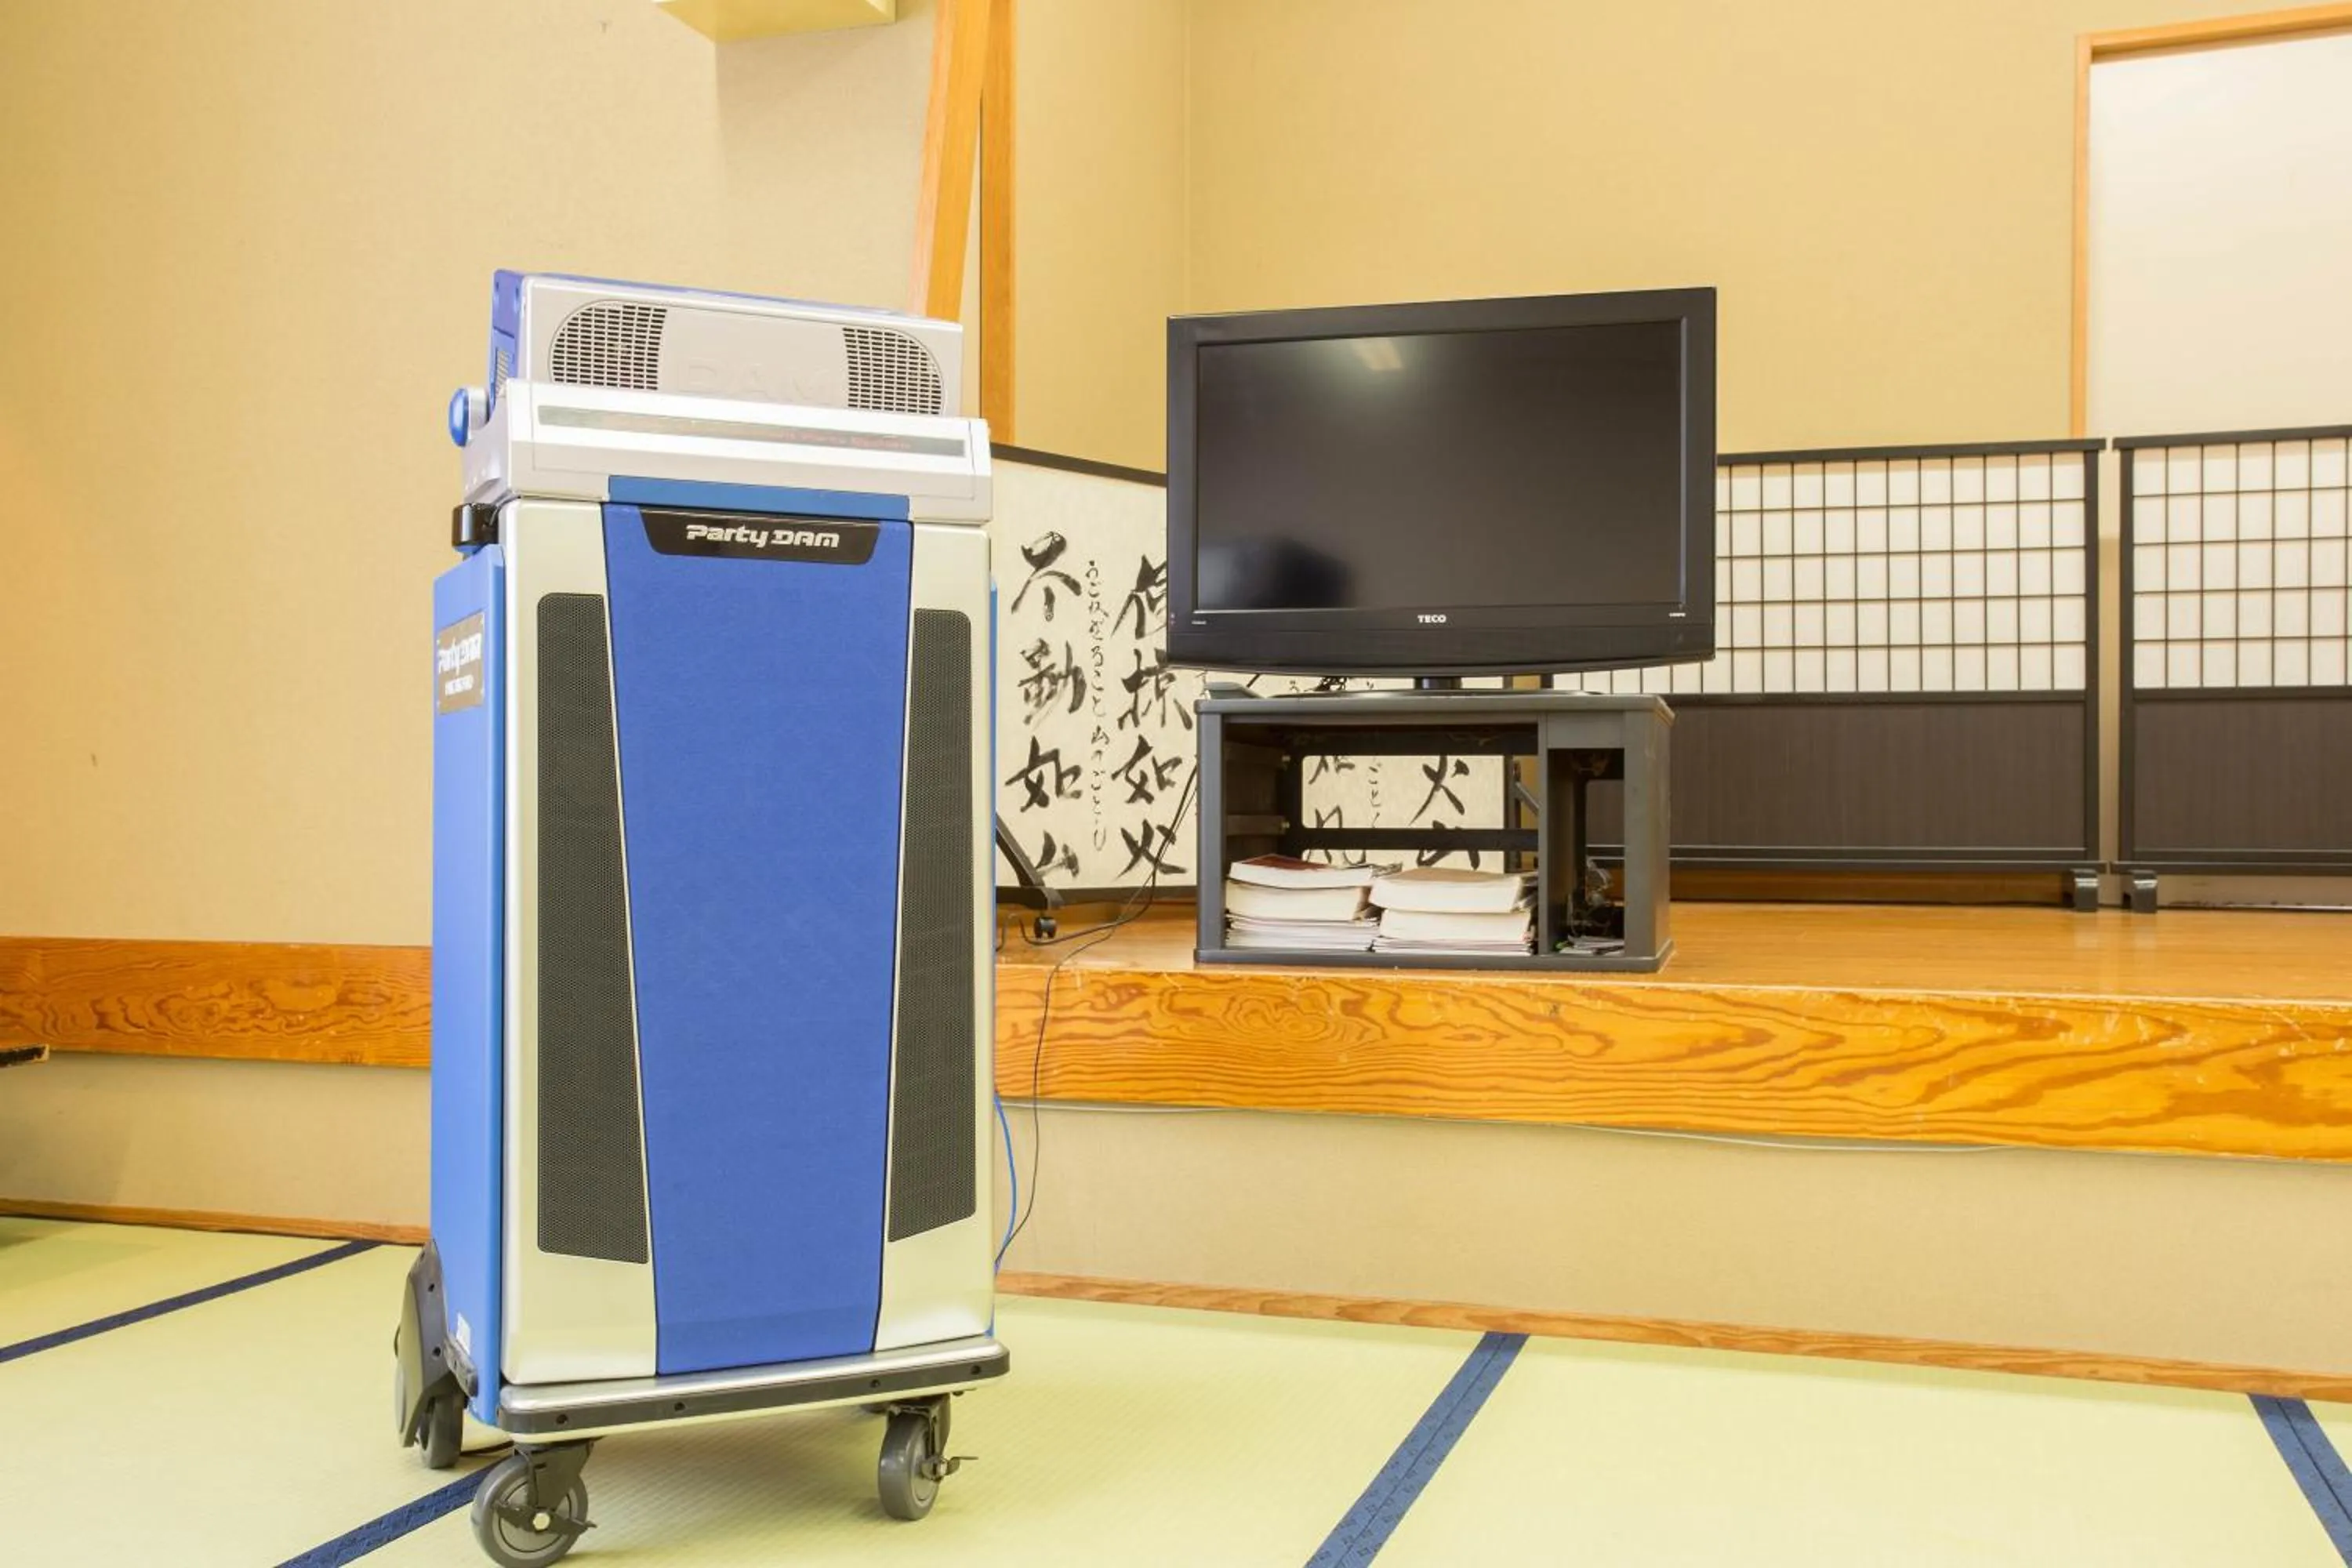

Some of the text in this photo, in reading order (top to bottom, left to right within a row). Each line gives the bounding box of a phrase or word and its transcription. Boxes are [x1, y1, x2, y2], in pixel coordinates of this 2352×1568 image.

[685, 524, 840, 548] Party DAM
[1417, 614, 1447, 624] TECO
